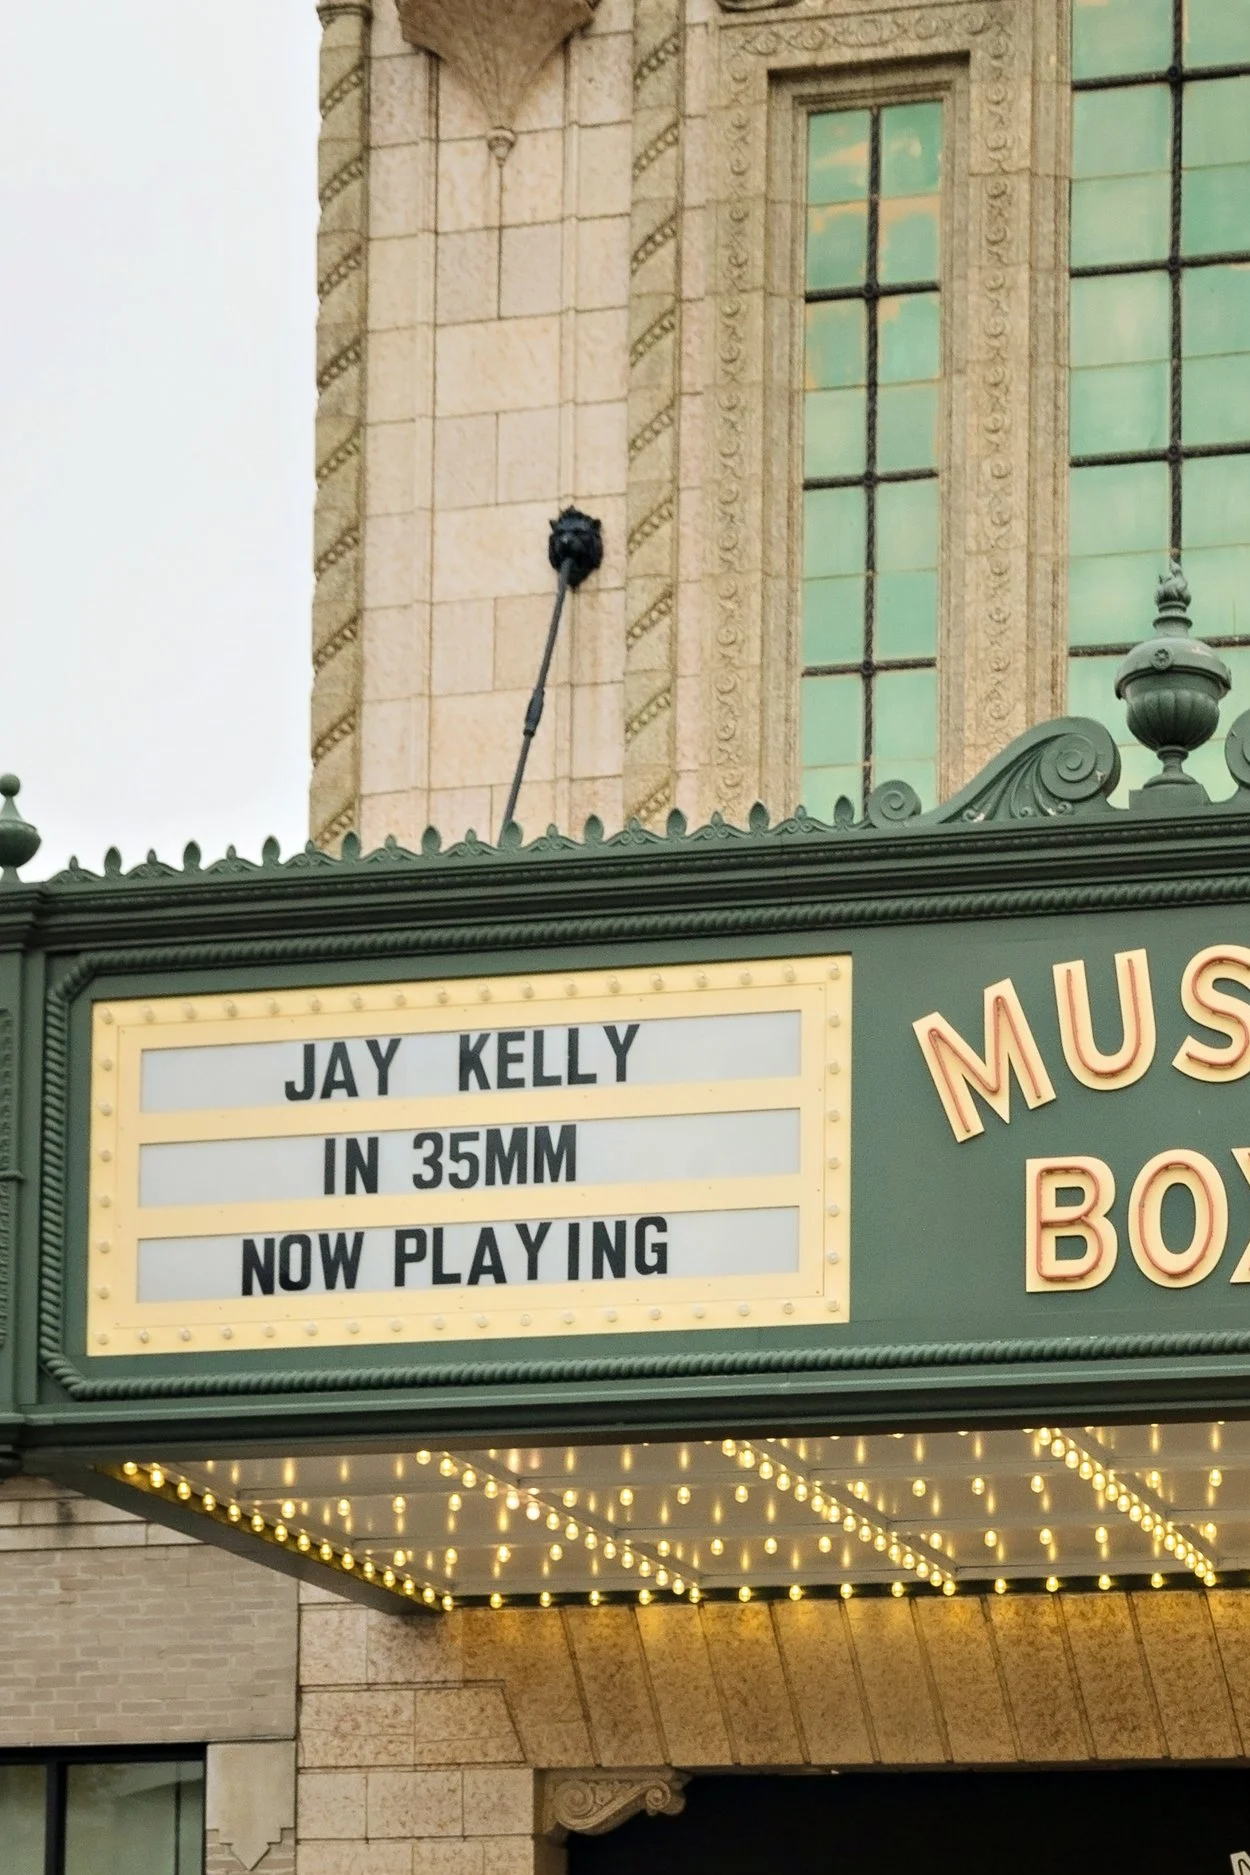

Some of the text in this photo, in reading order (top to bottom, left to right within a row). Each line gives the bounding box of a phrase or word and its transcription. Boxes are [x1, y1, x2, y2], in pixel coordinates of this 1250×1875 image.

[285, 1024, 639, 1101] JAY KELLY
[324, 1125, 576, 1195] IN 35MM
[242, 1216, 667, 1296] NOW PLAYING
